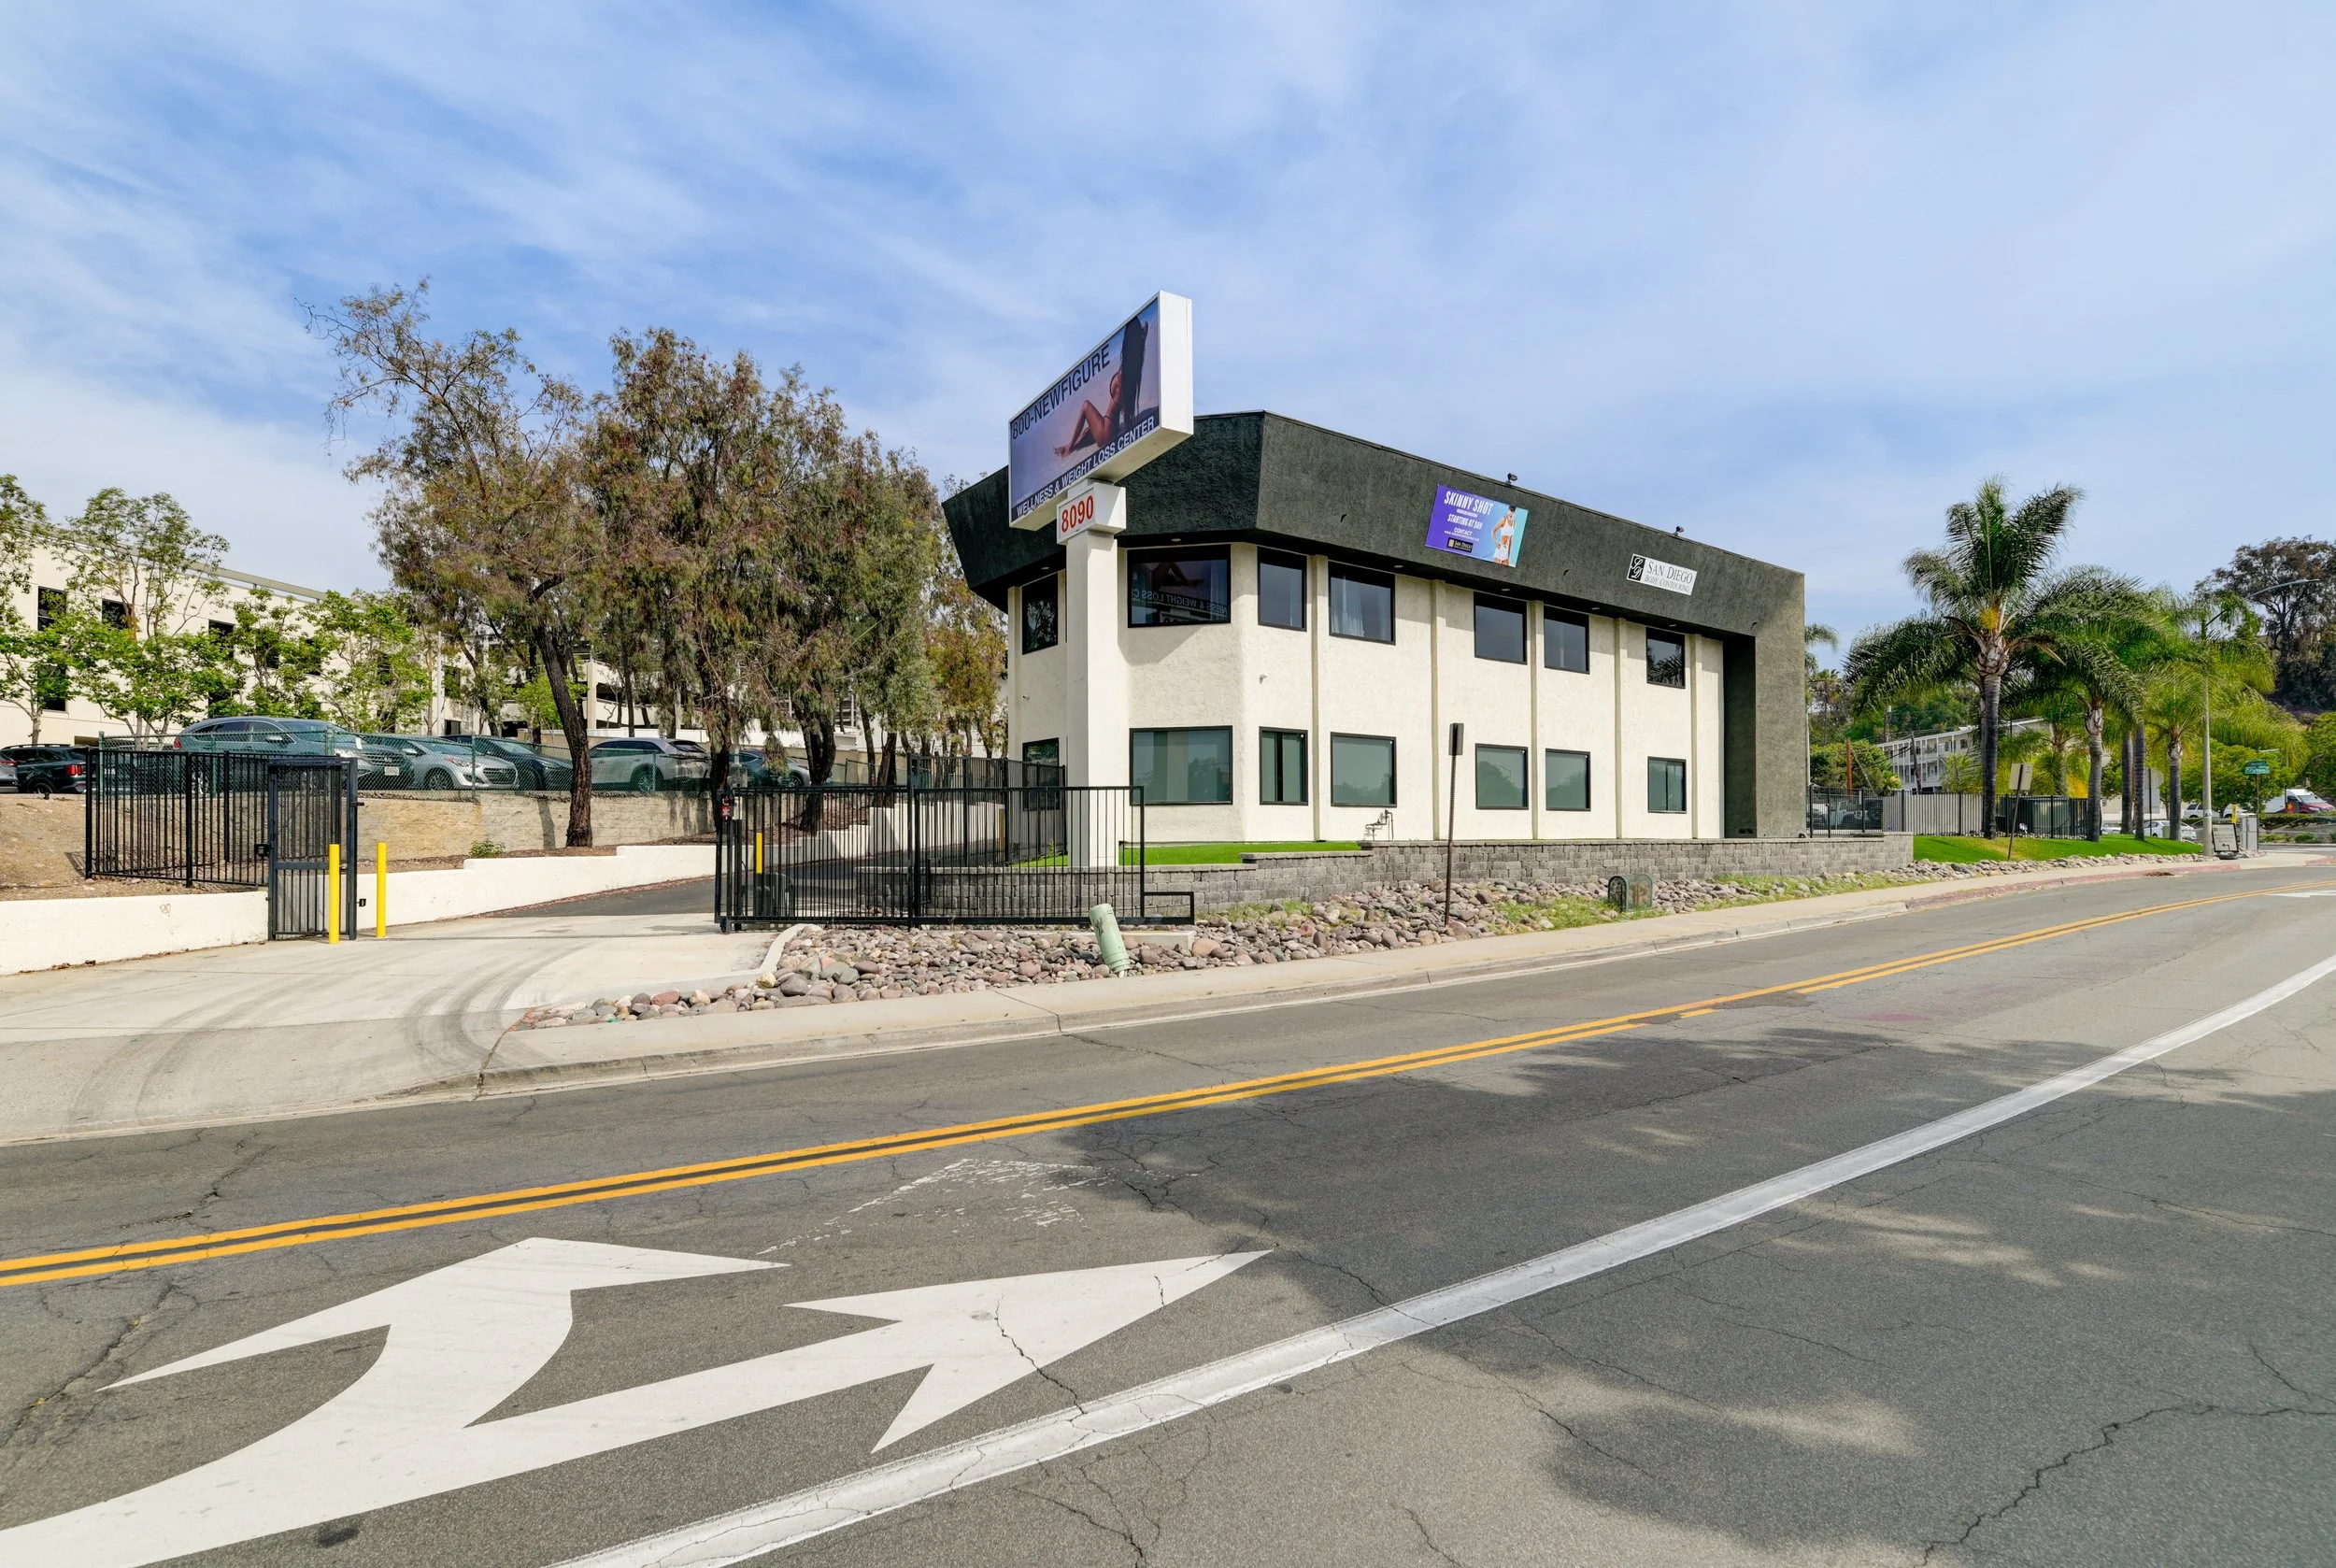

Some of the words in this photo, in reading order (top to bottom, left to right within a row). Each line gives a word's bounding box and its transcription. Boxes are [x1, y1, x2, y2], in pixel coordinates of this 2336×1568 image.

[1012, 343, 1111, 440] 800-NEWFIGURE
[1017, 484, 1053, 518] WELLNESS
[1054, 480, 1061, 492] &
[1061, 457, 1091, 488] WEIGHT
[1093, 441, 1116, 467] LOSS
[1118, 415, 1155, 450] CENTER
[1061, 494, 1094, 533] 8090
[1445, 491, 1474, 509] SKINNY
[1473, 499, 1493, 515] SHOT
[1447, 514, 1469, 526] STARTING
[1645, 574, 1659, 585] BODY
[1659, 578, 1690, 592] CONTOURING
[1647, 561, 1665, 576] SAN
[1667, 566, 1693, 584] DIEGO
